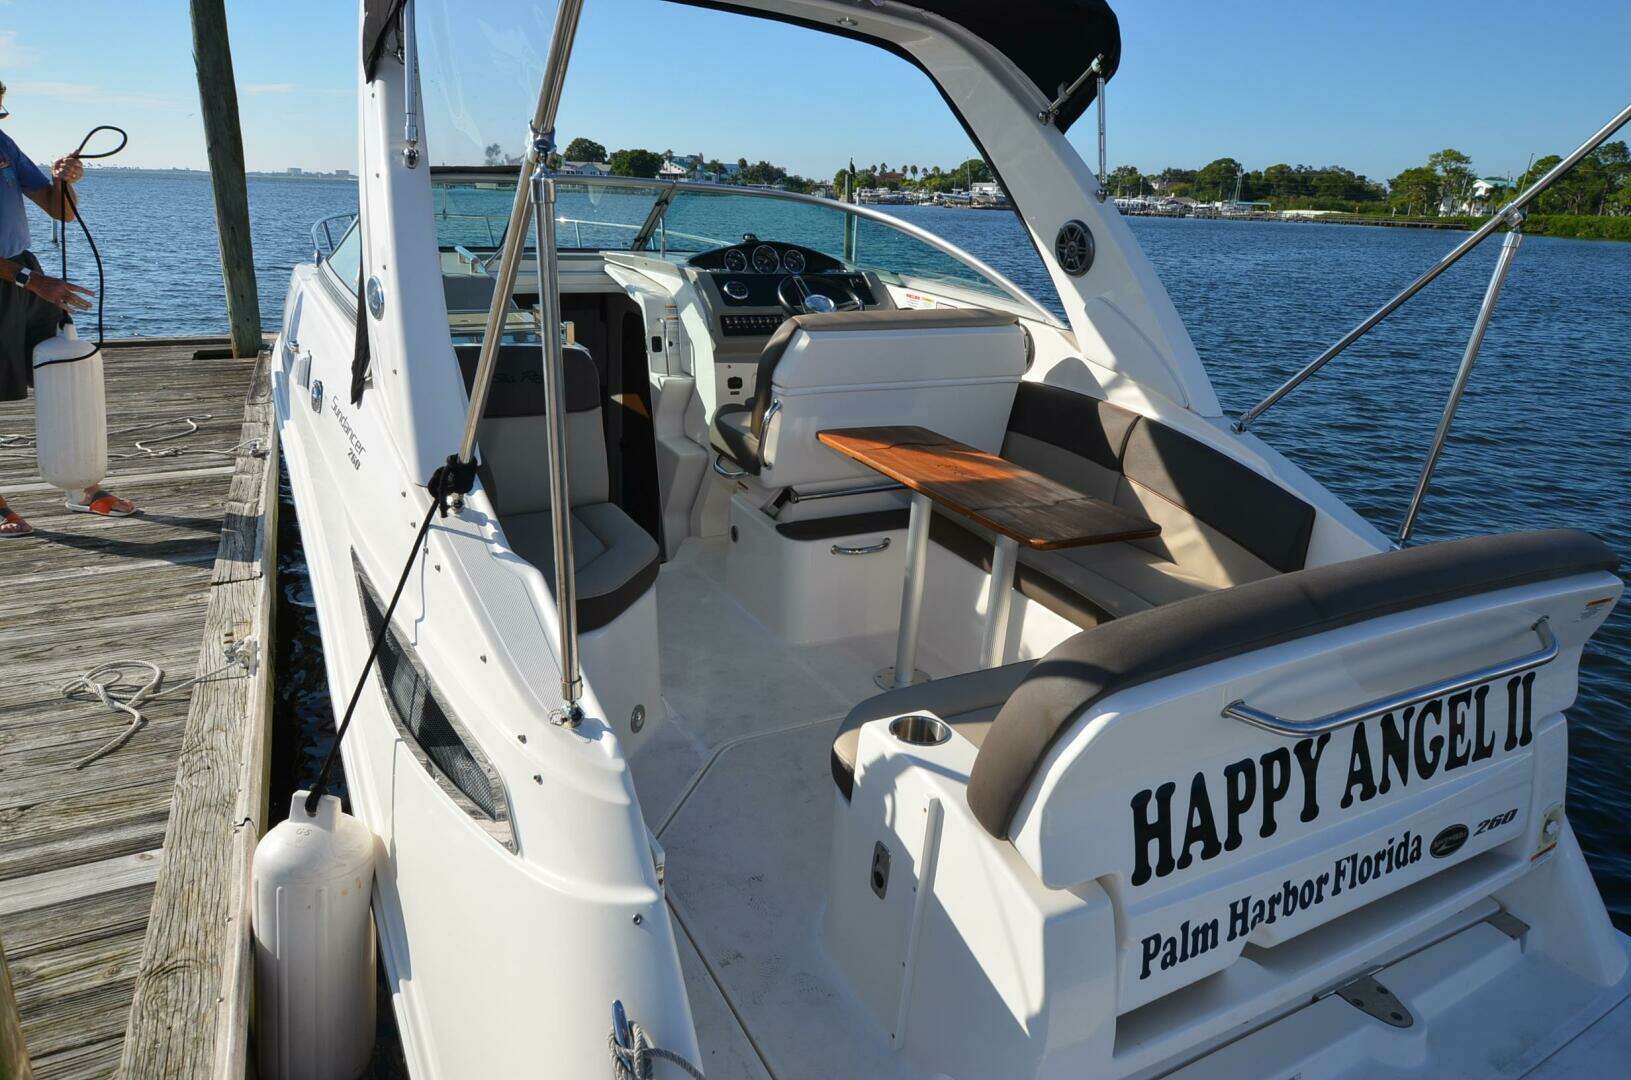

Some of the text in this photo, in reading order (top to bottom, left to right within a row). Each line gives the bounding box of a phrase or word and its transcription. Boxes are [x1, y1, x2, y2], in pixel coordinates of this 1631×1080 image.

[331, 395, 367, 455] Sundancer
[347, 447, 361, 471] 260
[1131, 671, 1537, 887] HAPPY ANGEL II
[1472, 808, 1519, 837] 260
[1139, 918, 1219, 980] Palm
[1226, 872, 1330, 943] Harbor
[1330, 830, 1423, 897] Florida
